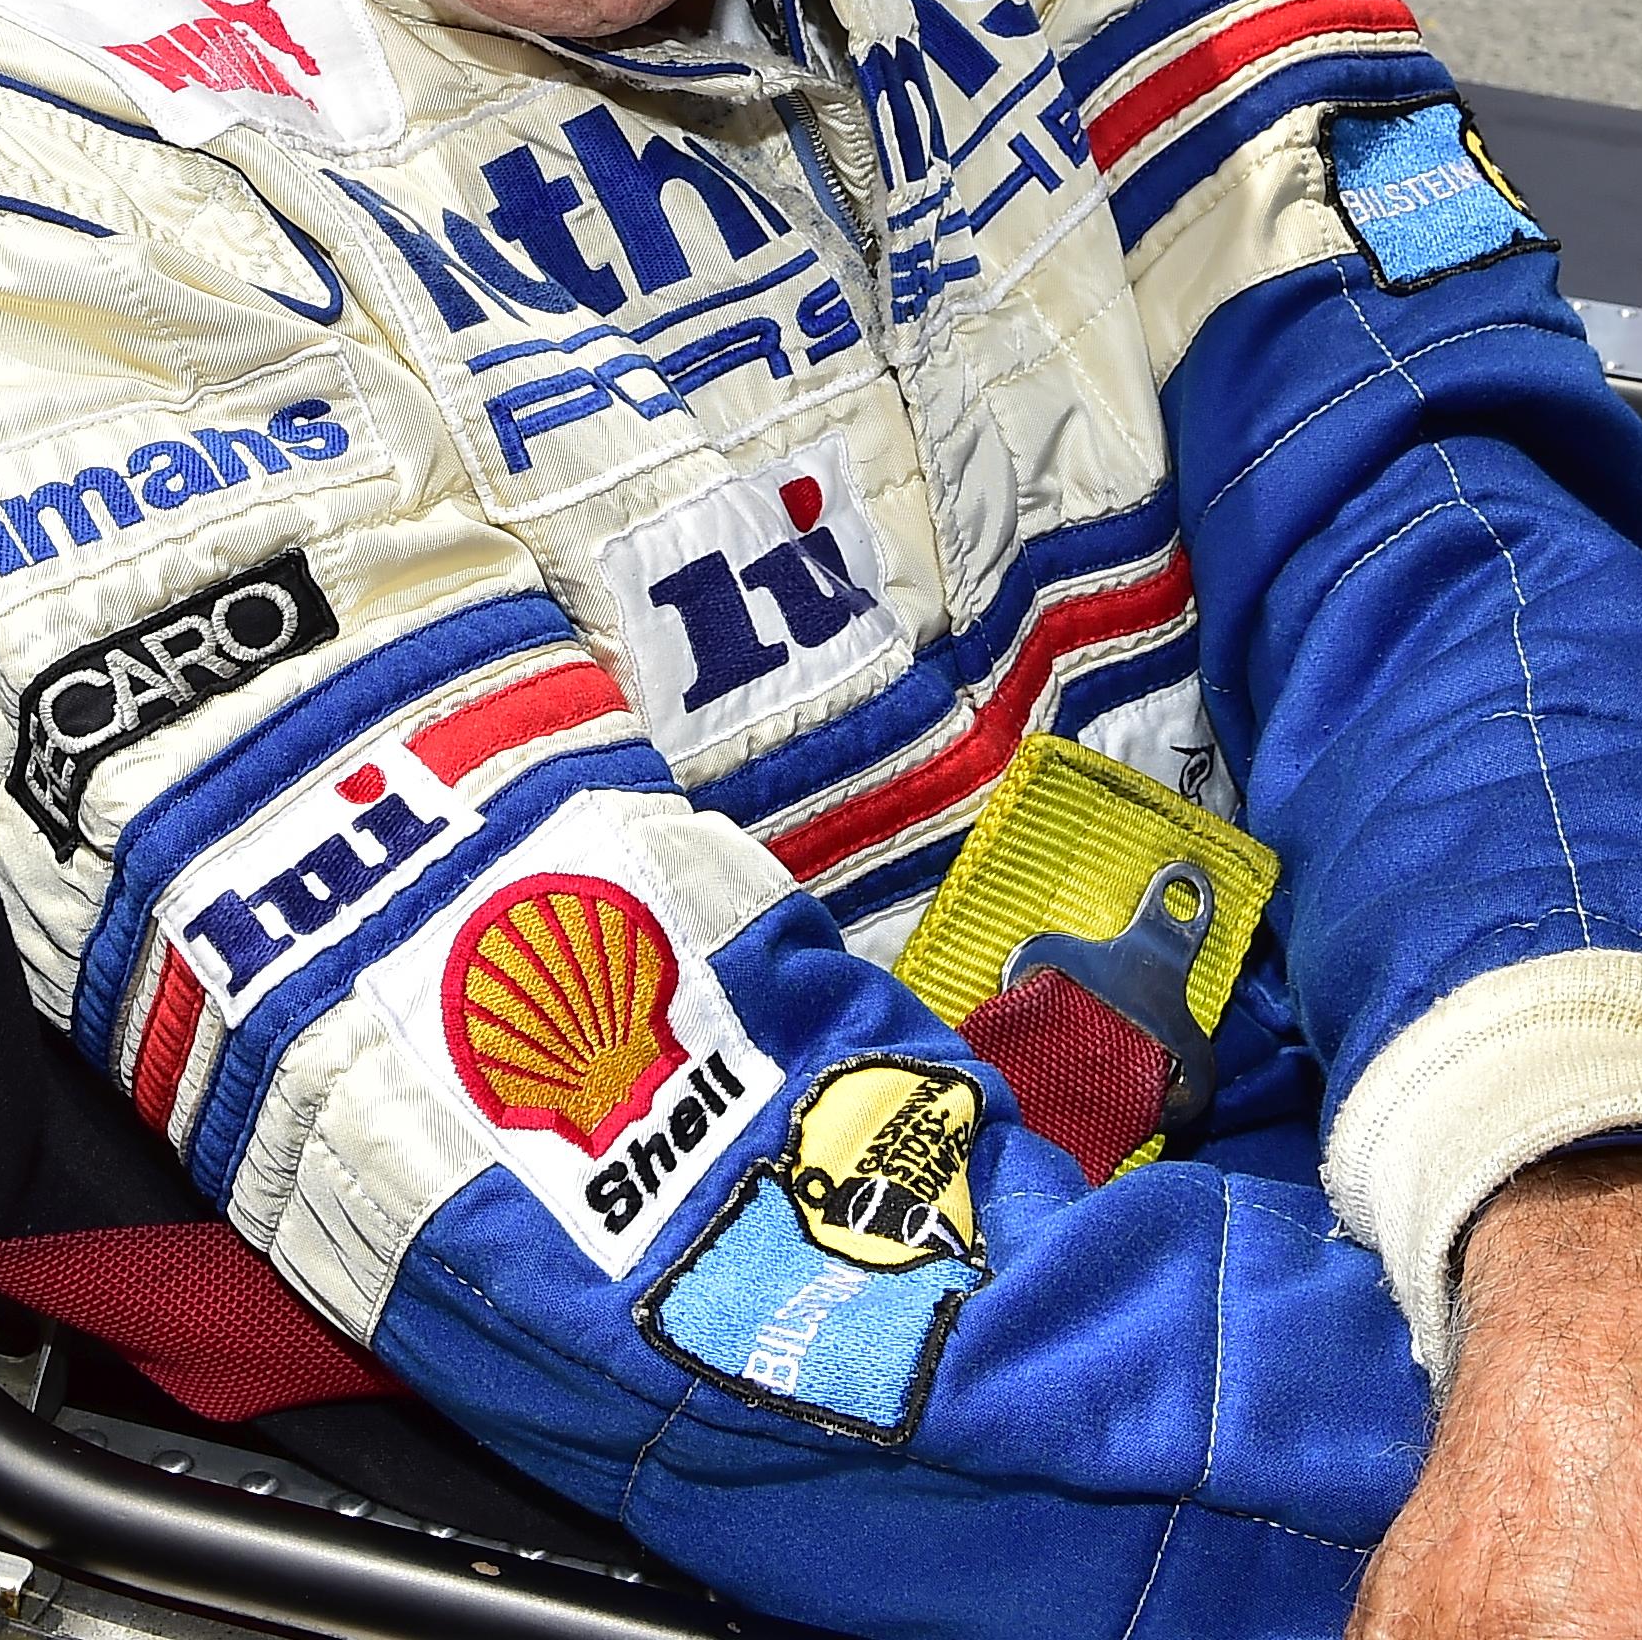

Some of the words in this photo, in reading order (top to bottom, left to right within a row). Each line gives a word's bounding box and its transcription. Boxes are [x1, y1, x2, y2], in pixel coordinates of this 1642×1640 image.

[1339, 155, 1483, 227] BILSTEIN
[183, 763, 450, 996] lui
[585, 1050, 746, 1236] Shell
